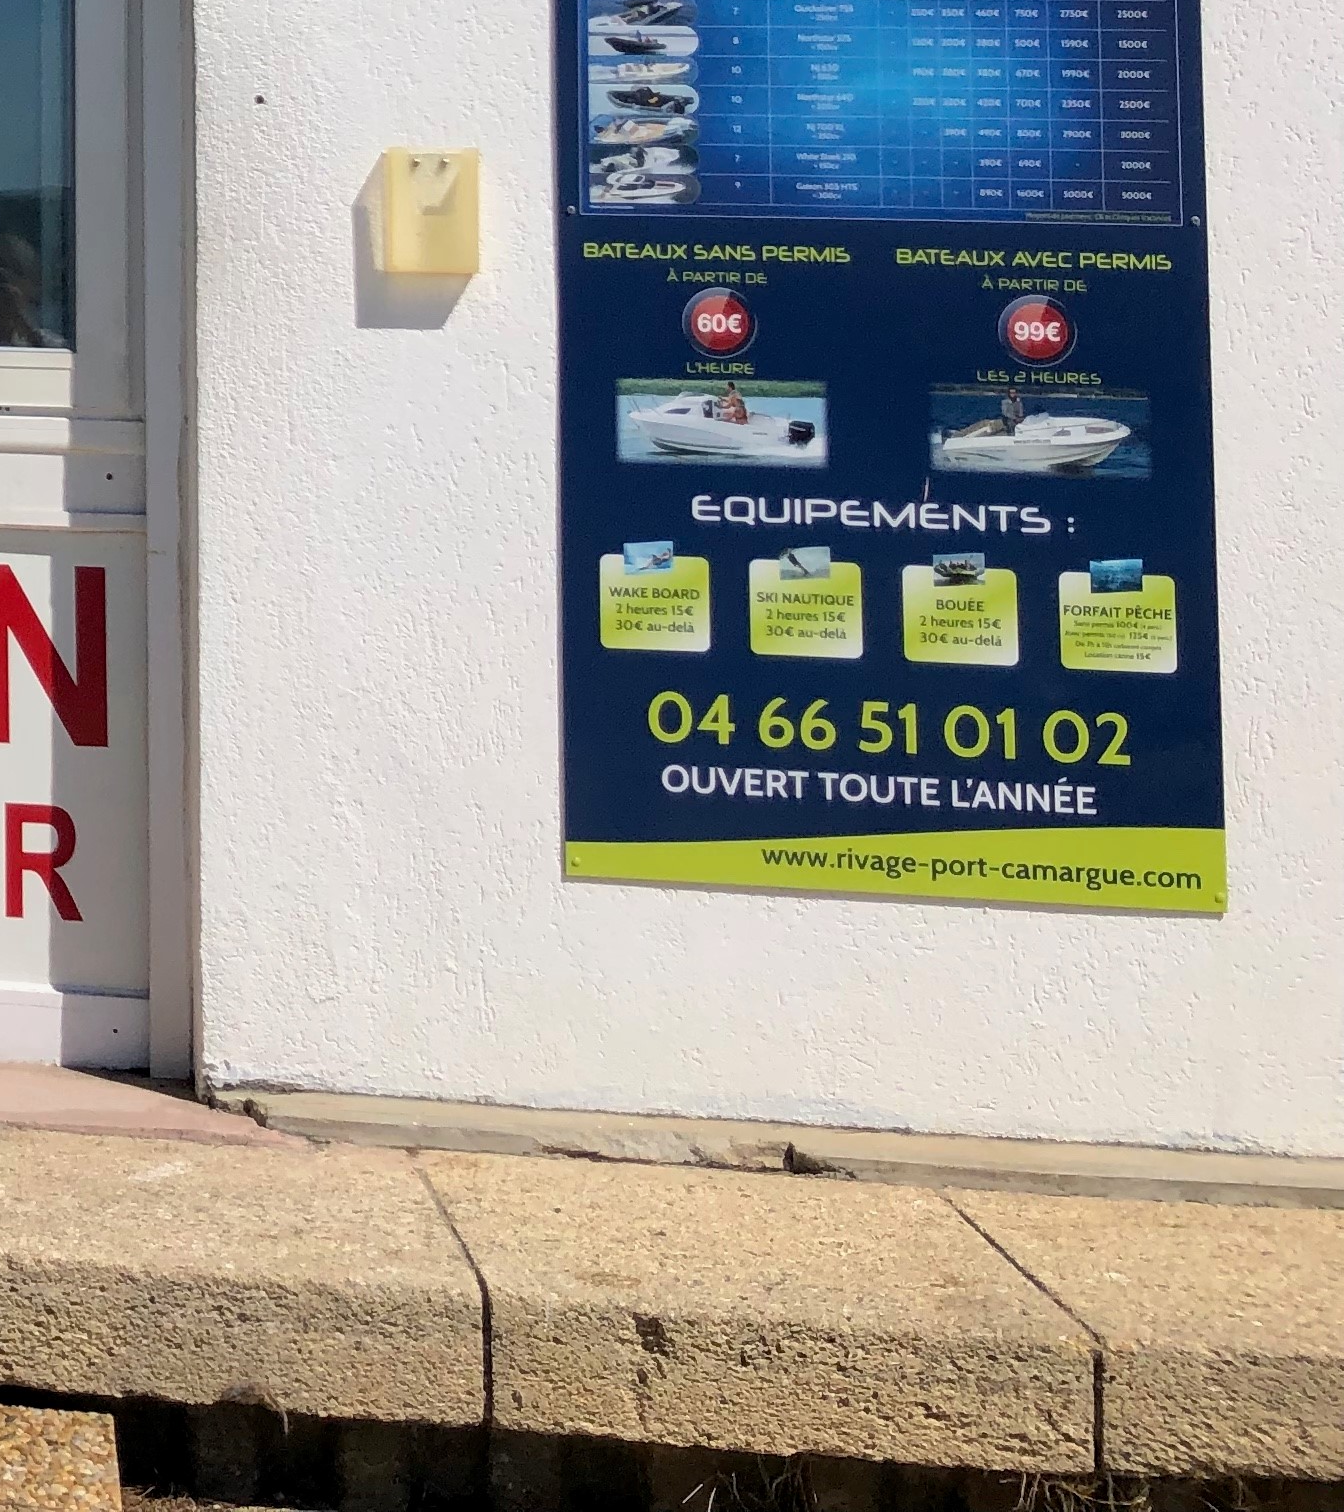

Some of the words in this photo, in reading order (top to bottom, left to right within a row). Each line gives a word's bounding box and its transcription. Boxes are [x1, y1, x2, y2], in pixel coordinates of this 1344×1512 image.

[1117, 10, 1148, 18] 2500€
[1014, 39, 1040, 47] 500€
[1118, 70, 1150, 79] 2000€
[1119, 100, 1150, 109] 2500€
[1121, 160, 1151, 169] 2000€
[1122, 191, 1152, 200] 5000€
[584, 243, 687, 259] BATEAUX
[694, 245, 756, 260] SANS
[762, 246, 850, 262] PERMIS
[897, 249, 1005, 266] BATEAUX
[1012, 251, 1072, 267] AVEC
[1080, 253, 1171, 269] PERMIS
[667, 268, 679, 281] À
[683, 272, 740, 283] PARTIR
[746, 273, 767, 283] DE
[982, 275, 993, 289] À
[998, 278, 1059, 290] PARTIR
[1064, 280, 1087, 291] DE
[697, 313, 741, 333] 60€
[1014, 321, 1060, 341] 99€
[687, 362, 754, 374] L'HEURE
[977, 371, 1009, 382] LES
[1014, 371, 1026, 382] 2
[1031, 372, 1101, 384] HEURES
[692, 495, 1051, 533] EQUIPEMENTS
[1068, 517, 1074, 533] :
[609, 587, 648, 598] WAKE
[652, 588, 699, 599] BOARD
[757, 592, 778, 603] SKI
[782, 593, 854, 606] NAUTIQUE
[616, 603, 622, 613] 2
[627, 603, 667, 615] heures
[671, 606, 694, 616] 15€
[937, 600, 984, 612] BOUÉE
[1064, 605, 1121, 618] FORFAIT
[1126, 605, 1172, 620] PÊCHE
[766, 609, 773, 619] 2
[777, 609, 818, 621] heures
[823, 612, 845, 622] 15€
[616, 620, 642, 630] 30€
[647, 622, 694, 633] au-delà
[920, 616, 926, 626] 2
[931, 616, 973, 628] heures
[978, 618, 1001, 629] 15€
[1116, 621, 1138, 629] 100€
[766, 625, 794, 636] 30€
[798, 628, 846, 639] au-delà
[921, 632, 948, 643] 30€
[952, 635, 1001, 646] au-delà
[1136, 652, 1151, 660] 15€
[648, 691, 735, 744] 04
[759, 697, 836, 750] 66
[859, 701, 917, 754] 51
[944, 705, 1015, 759] 01
[1043, 710, 1130, 765] 02
[662, 765, 809, 798] OUVERT
[818, 772, 940, 806] TOUTE
[952, 777, 1097, 814] L'ANNÉE
[762, 849, 1201, 890] www.rivage-port-camargue.com
